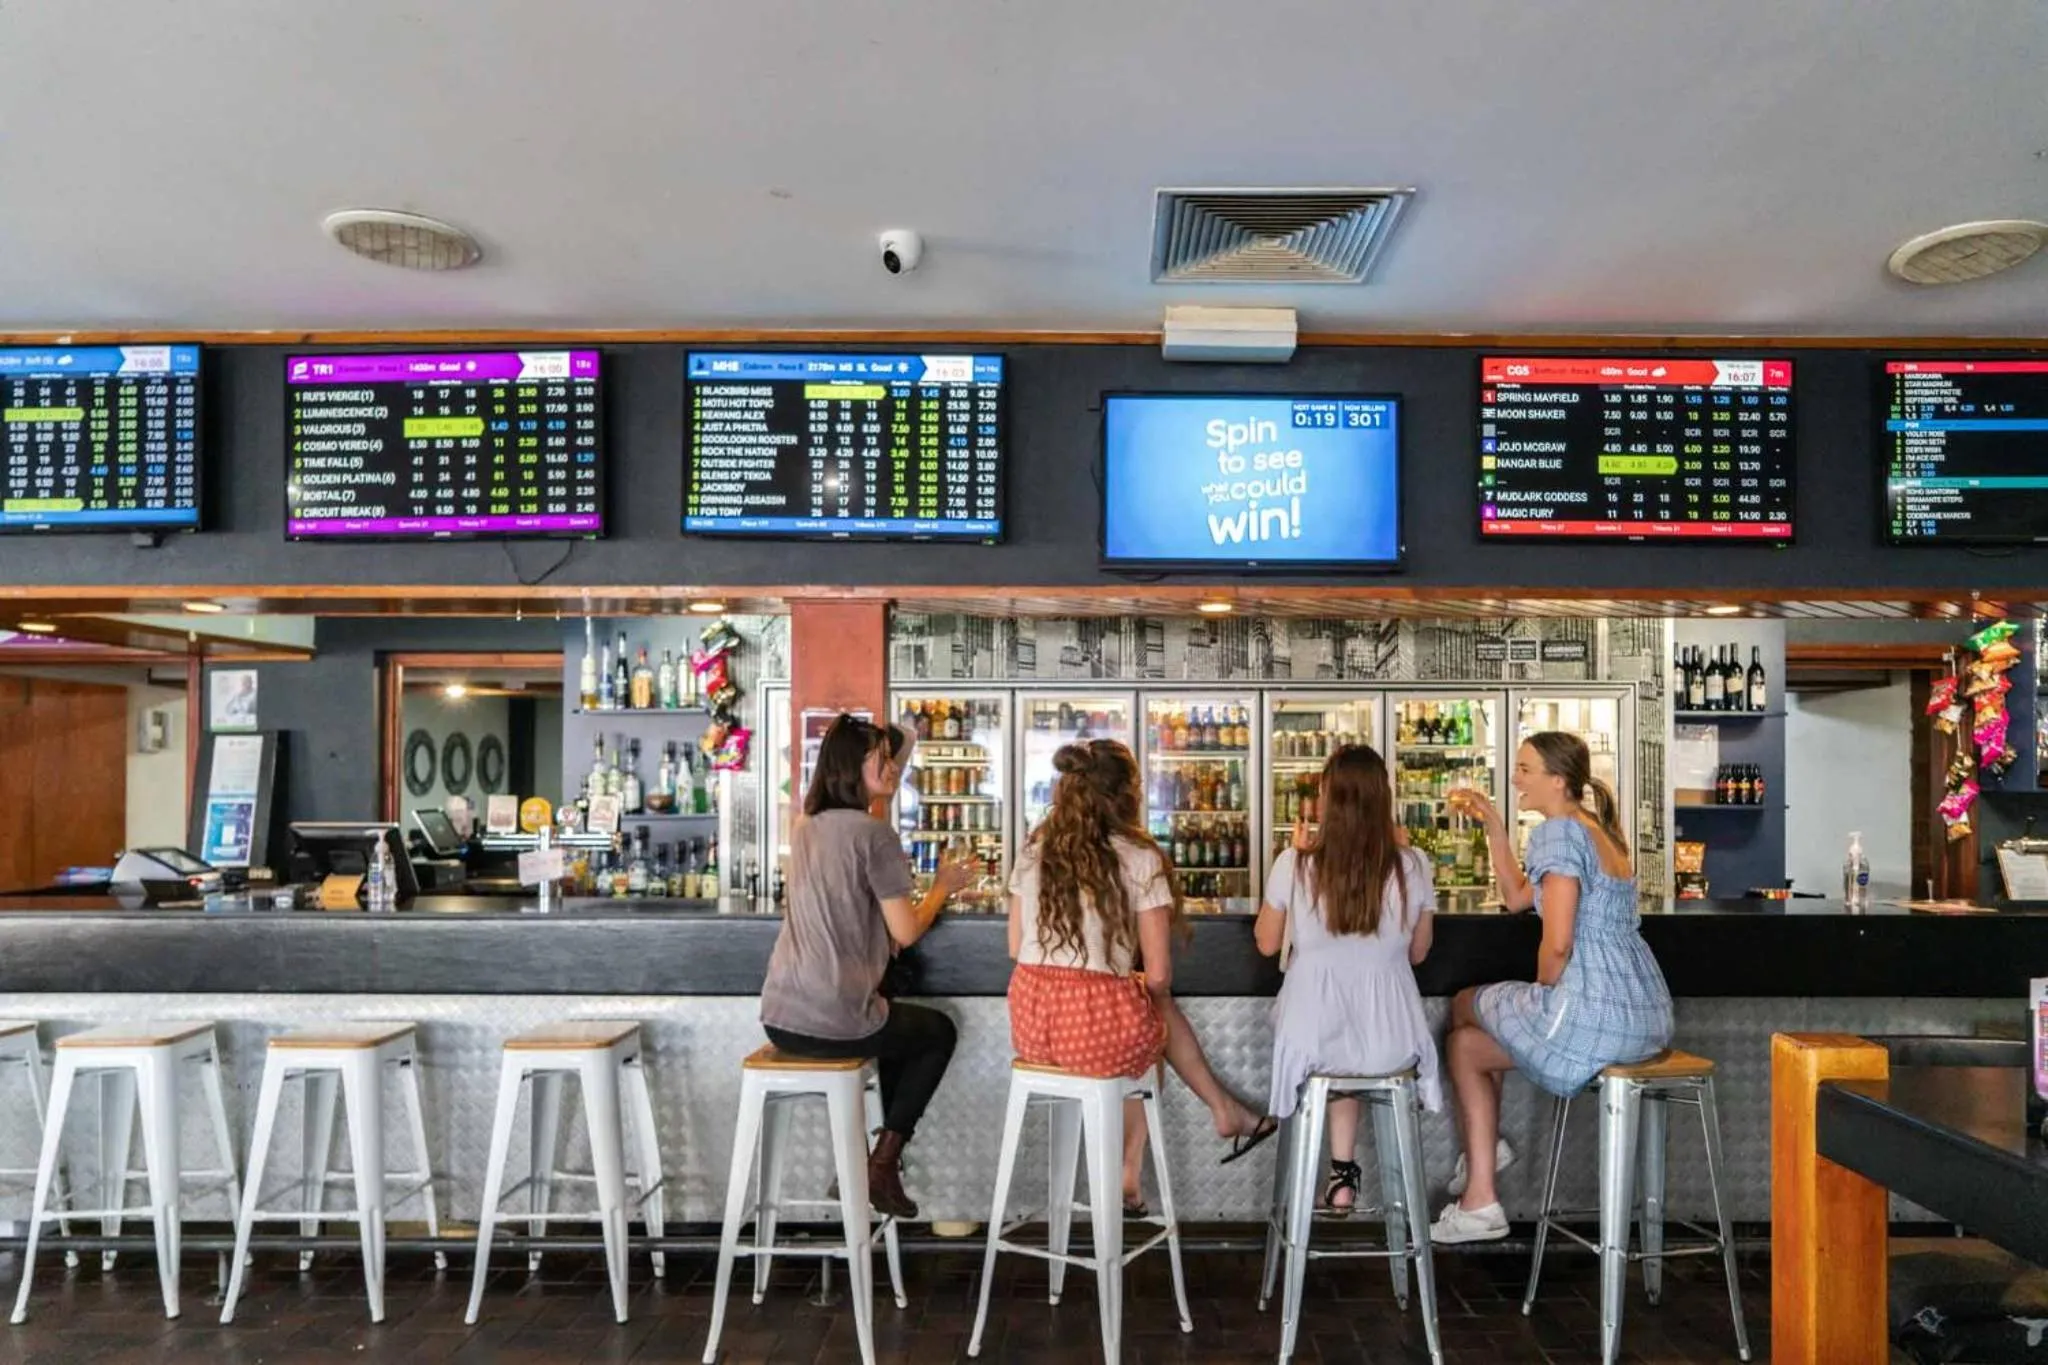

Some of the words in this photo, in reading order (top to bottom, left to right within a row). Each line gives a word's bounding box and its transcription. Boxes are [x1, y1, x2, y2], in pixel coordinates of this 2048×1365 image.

[313, 364, 334, 375] TR1
[1497, 392, 1532, 402] SPRING
[1534, 392, 1579, 402] MAYFIELD
[728, 400, 747, 408] HOT
[748, 400, 774, 408] TOPIC
[743, 411, 766, 420] ALEX
[1295, 412, 1336, 426] 0:19
[1497, 410, 1526, 419] MOON
[1528, 410, 1566, 419] SHAKER
[1348, 413, 1381, 427] 301
[302, 424, 351, 435] VALOROUS
[702, 423, 724, 432] JUST
[1604, 427, 1621, 435] SCR
[1685, 428, 1702, 436] SCR
[1713, 428, 1730, 437] SCR
[1741, 429, 1758, 437] SCR
[1769, 429, 1786, 437] SCR
[1206, 416, 1278, 453] Spin
[302, 441, 338, 451] COSMO
[1496, 442, 1522, 452] JOJO
[1524, 442, 1566, 452] MCGRAW
[702, 448, 725, 456] ROCK
[727, 448, 744, 456] THE
[744, 448, 777, 456] NATION
[303, 458, 326, 468] TIME
[327, 457, 350, 468] FALL
[738, 459, 776, 468] FIGHTER
[1218, 450, 1246, 476] to
[1253, 450, 1303, 471] see
[1497, 460, 1536, 468] NANGAR
[1538, 460, 1562, 468] BLUE
[302, 474, 340, 484] GOLDEN
[1604, 477, 1621, 485] SCR
[1713, 478, 1729, 487] SCR
[1230, 470, 1308, 500] could
[744, 495, 786, 505] ASSASSIN
[1496, 492, 1542, 502] MUDLARK
[1544, 492, 1588, 502] GODDESS
[302, 508, 339, 518] CIRCUIT
[340, 506, 372, 517] BREAK
[700, 508, 719, 516] FOR
[1496, 508, 1527, 518] MAGIC
[1529, 508, 1554, 518] FURY
[1207, 497, 1301, 546] win!
